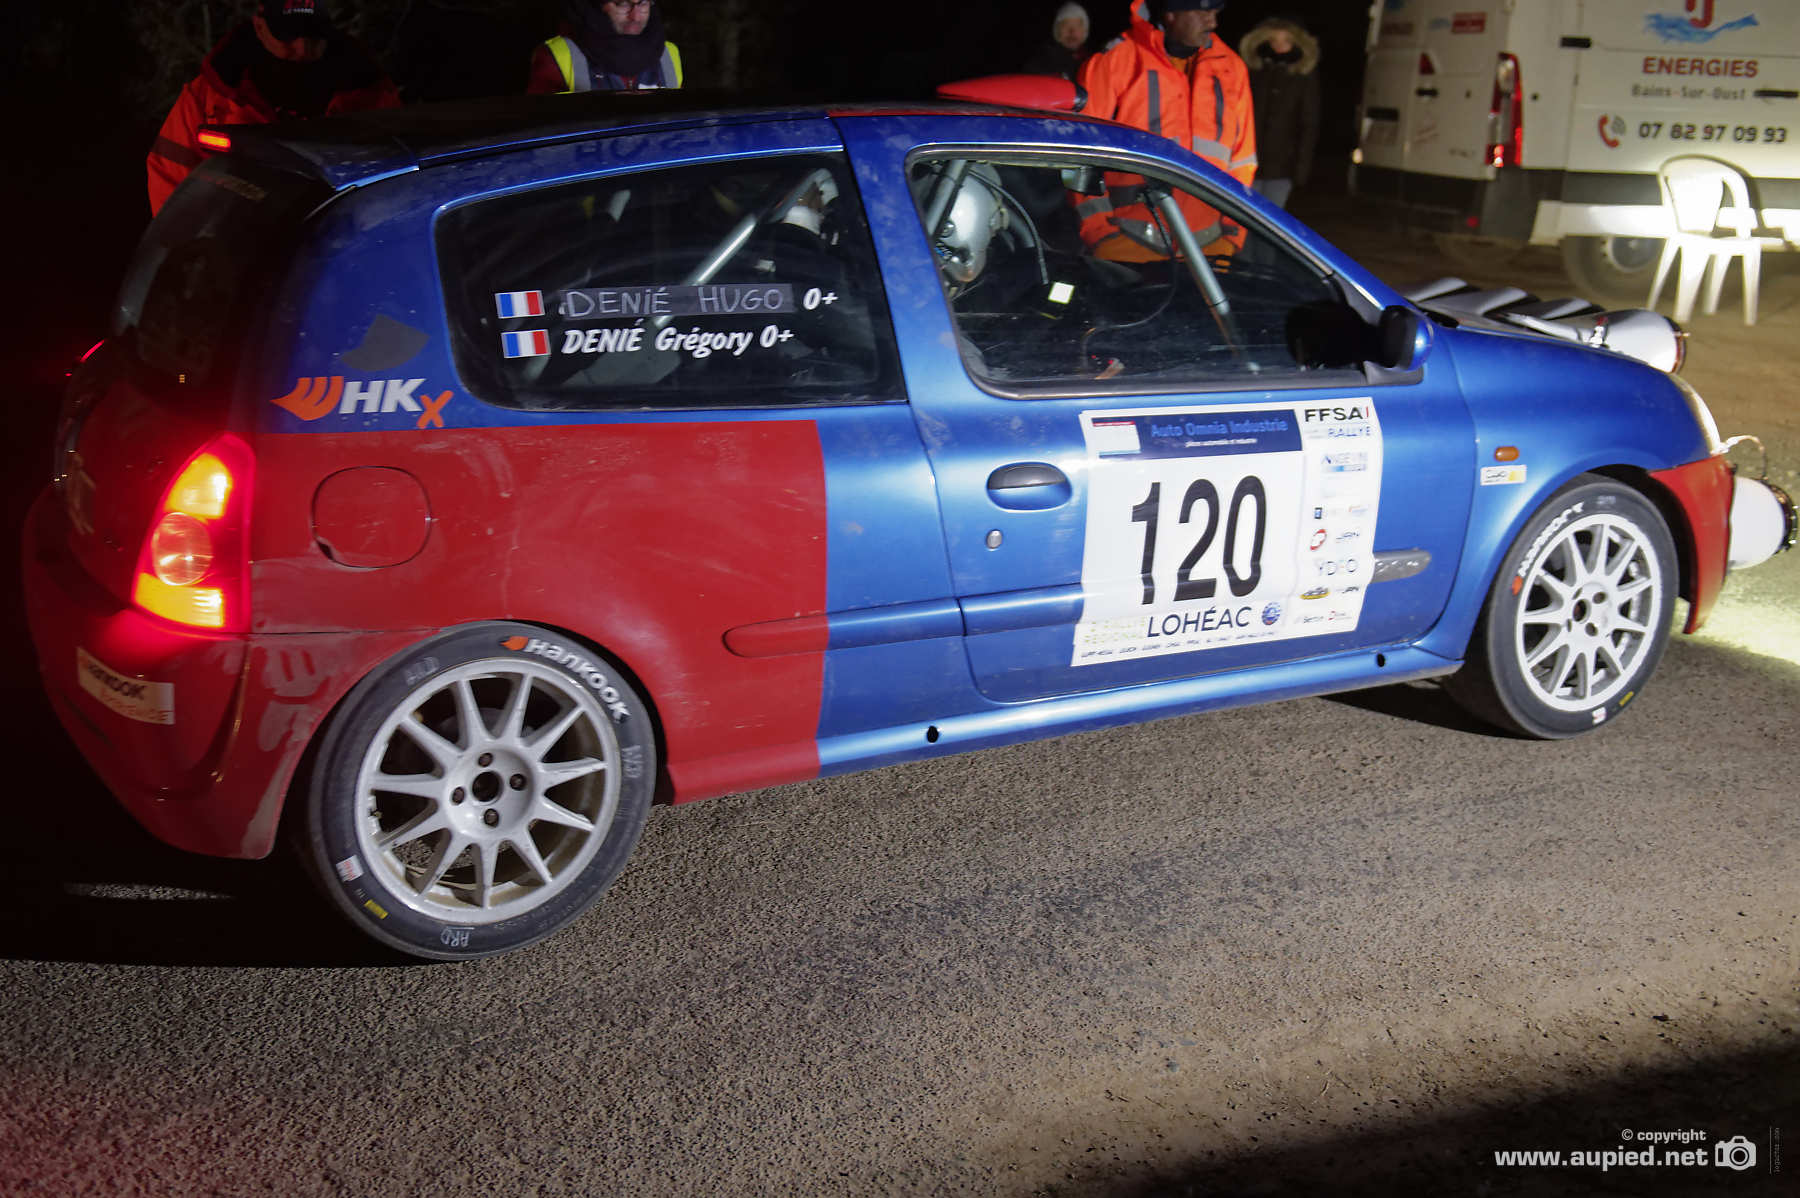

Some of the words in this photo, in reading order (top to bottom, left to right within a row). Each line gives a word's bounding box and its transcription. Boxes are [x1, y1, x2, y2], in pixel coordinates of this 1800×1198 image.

[1642, 56, 1759, 78] ENERGIES
[1639, 122, 1664, 139] 07
[1670, 124, 1697, 140] 82
[1702, 124, 1727, 141] 97
[1733, 126, 1758, 142] 09
[1763, 127, 1788, 143] 93
[698, 286, 783, 313] HUGO
[561, 318, 646, 354] DENIÉ
[654, 326, 754, 358] Grégory
[1304, 407, 1363, 422] FFSA
[1131, 475, 1267, 606] 120
[1147, 606, 1253, 638] LOHÉAC
